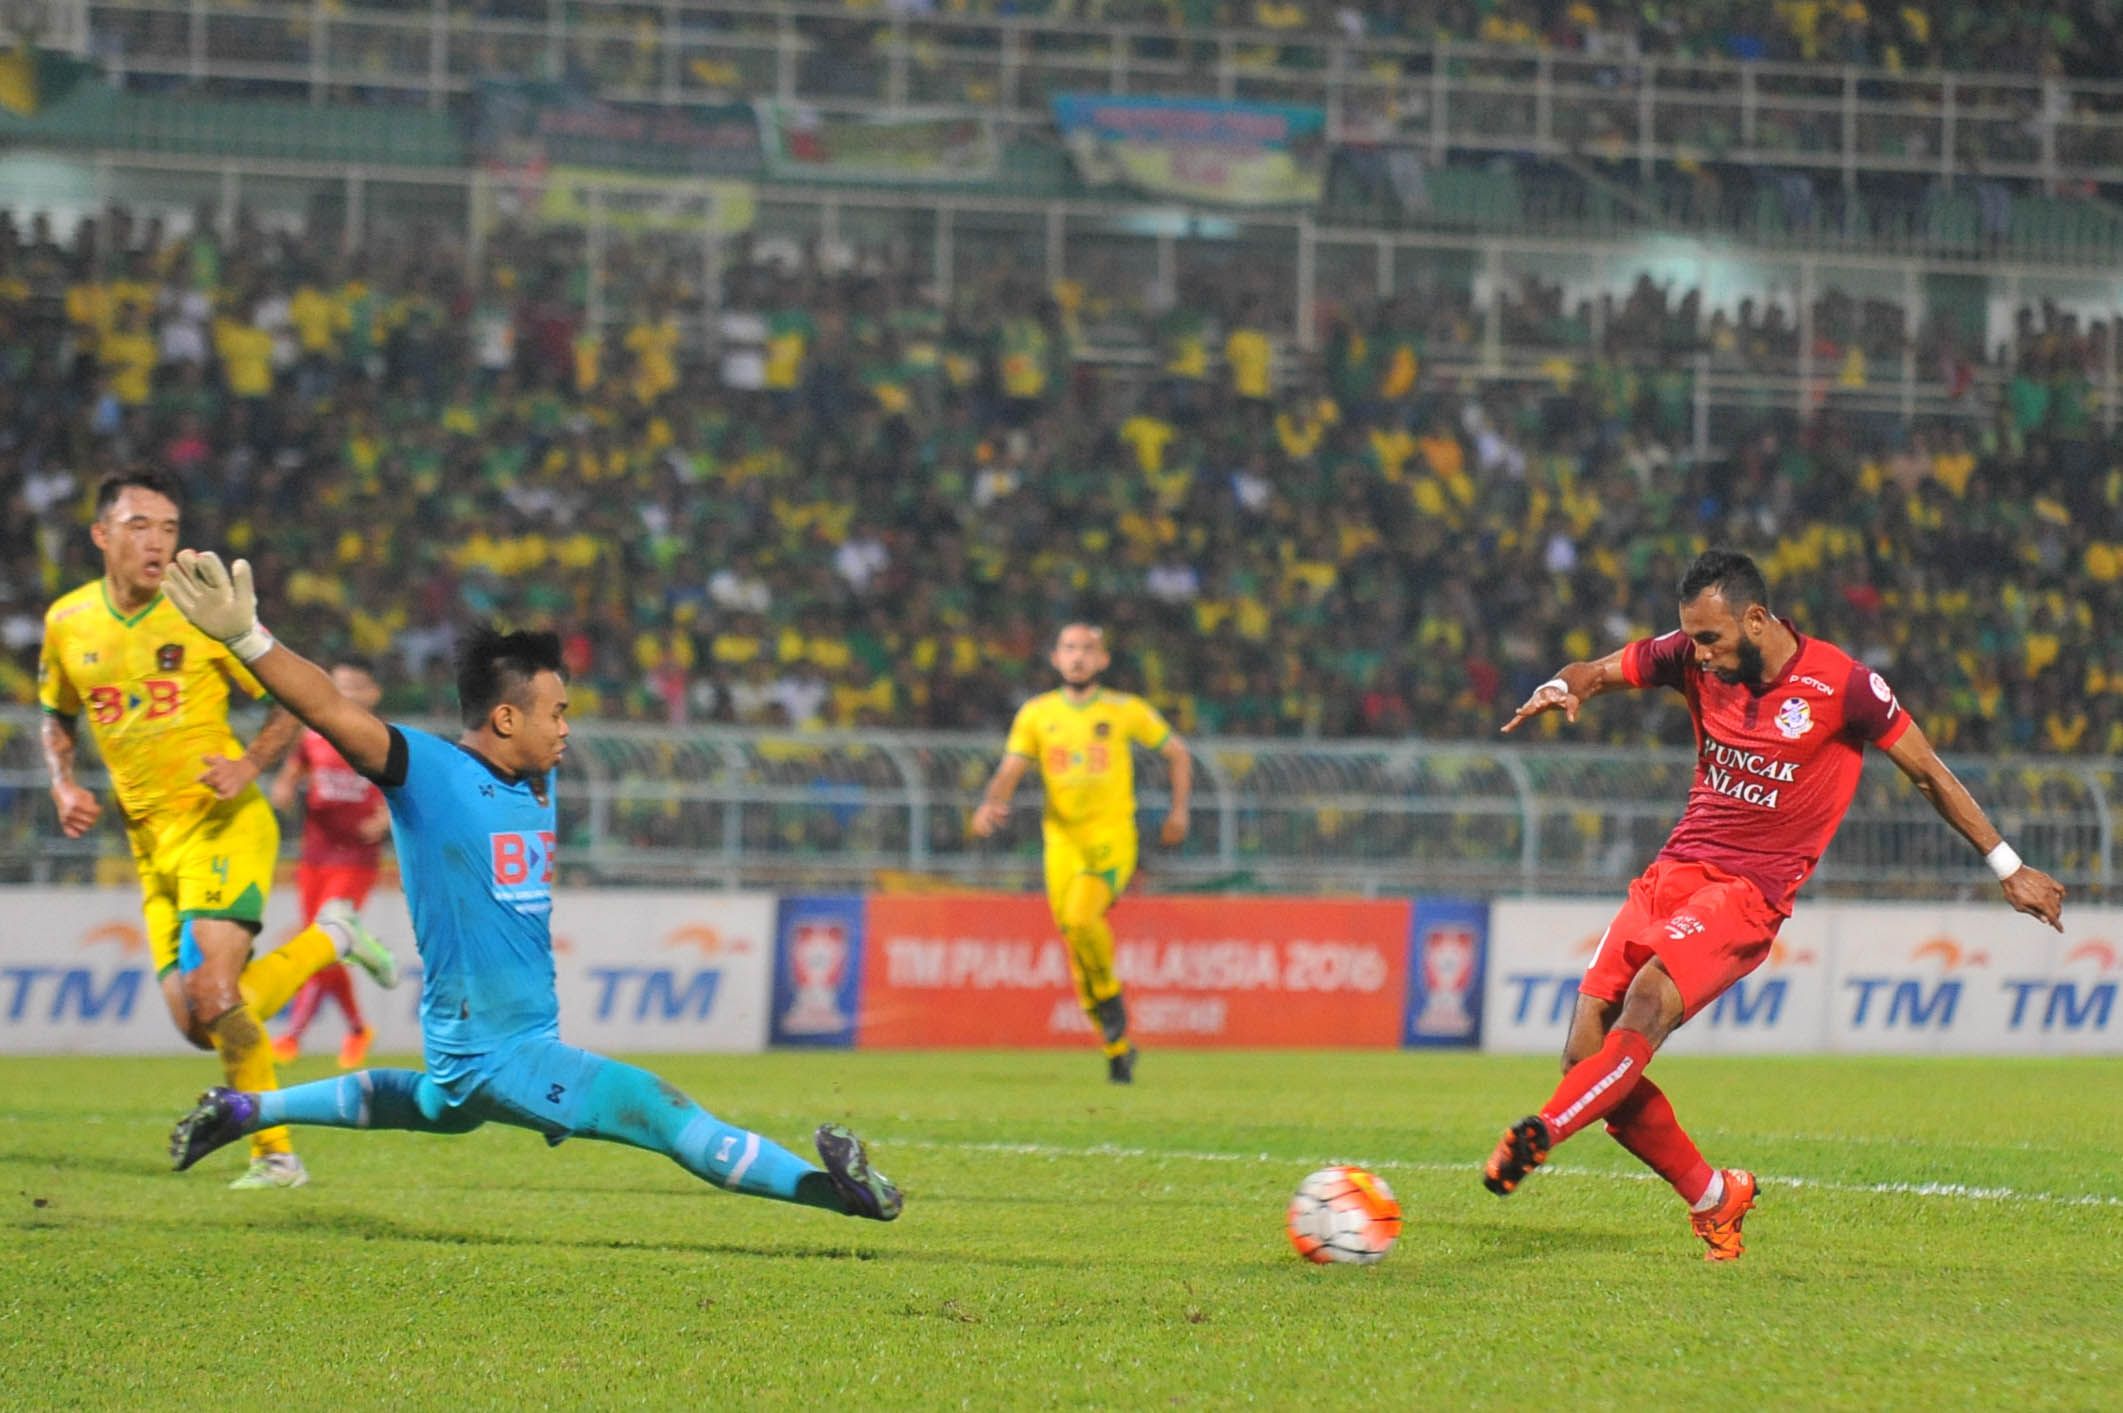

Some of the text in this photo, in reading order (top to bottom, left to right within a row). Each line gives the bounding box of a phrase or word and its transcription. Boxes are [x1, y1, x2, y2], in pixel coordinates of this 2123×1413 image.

[1704, 736, 1801, 783] PUNCAK
[1703, 763, 1779, 809] NIAGA
[211, 855, 228, 884] 4
[1112, 938, 1280, 990] ALAYSIA
[1284, 940, 1388, 993] 2016
[0, 966, 143, 1023] TM
[587, 966, 722, 1022] TM
[1711, 975, 1791, 1027] M
[1845, 977, 1963, 1028] TM
[2003, 979, 2119, 1030] TM
